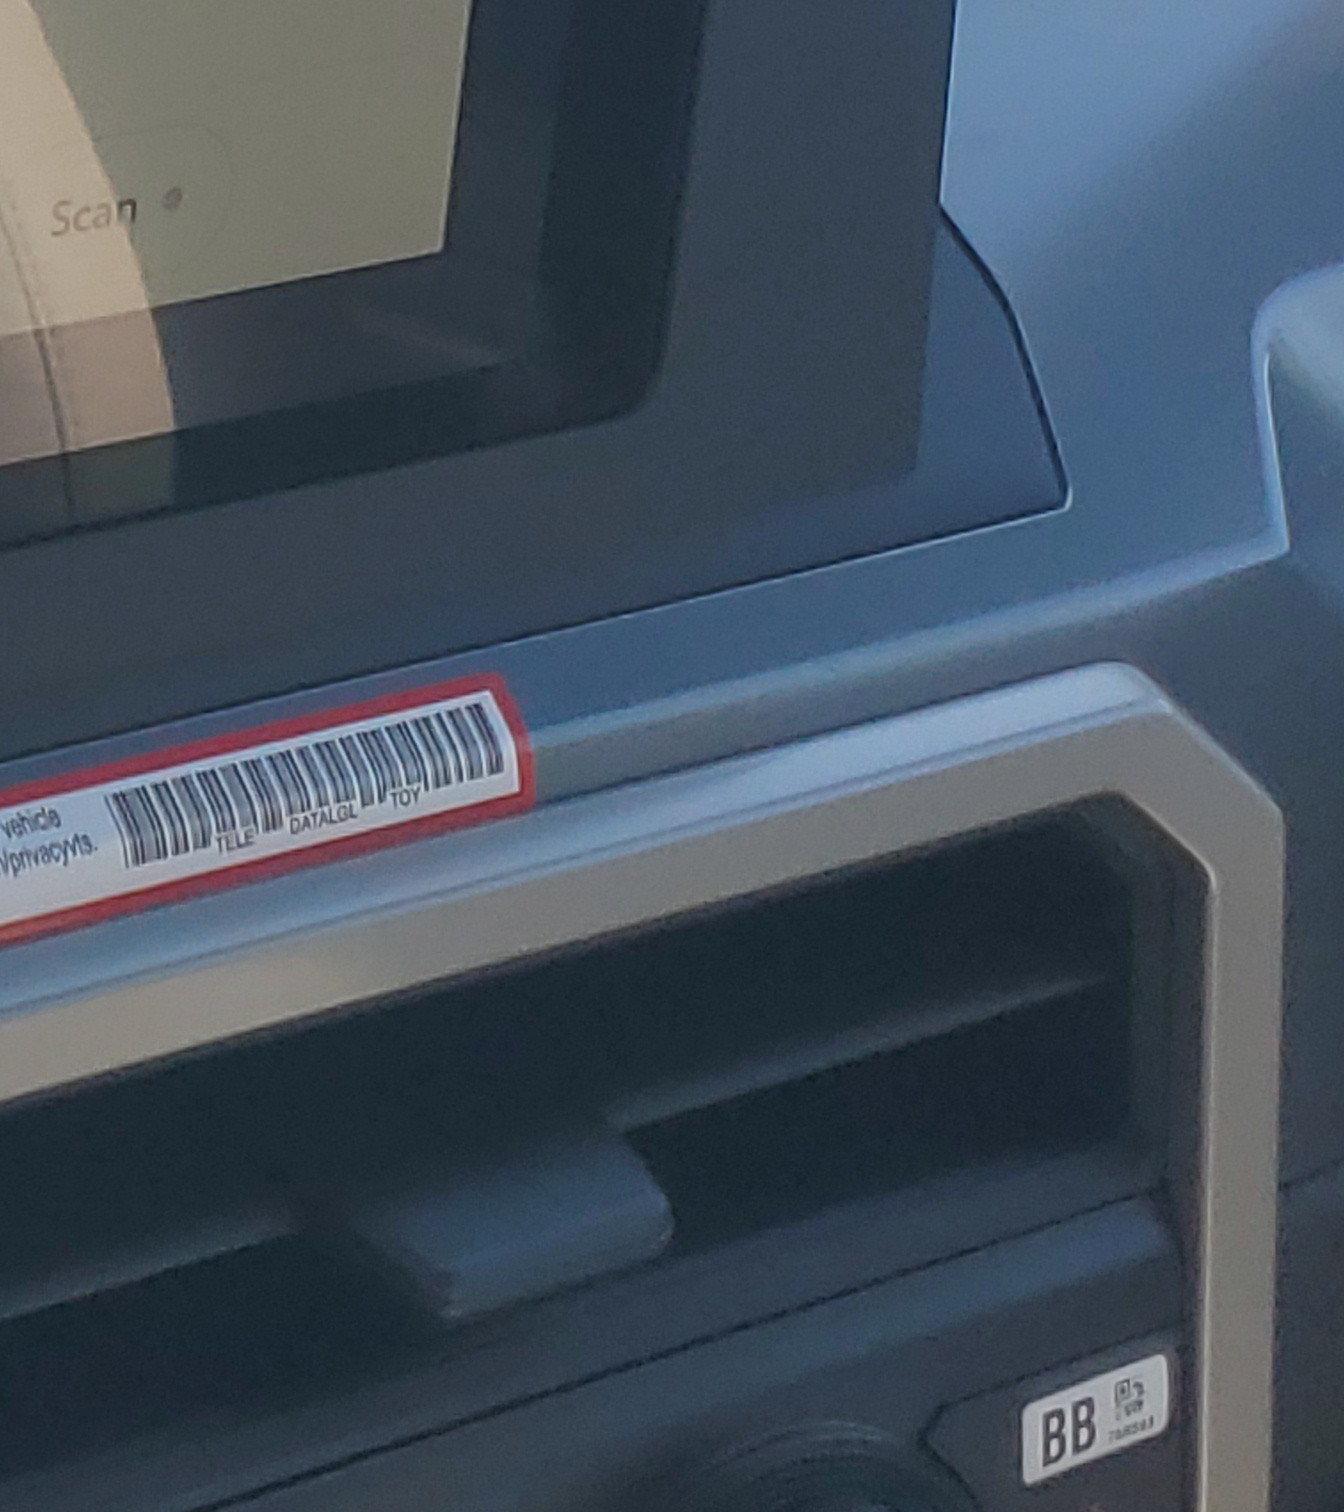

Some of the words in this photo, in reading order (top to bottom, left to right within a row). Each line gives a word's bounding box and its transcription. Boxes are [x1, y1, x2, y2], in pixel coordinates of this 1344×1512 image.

[50, 196, 138, 238] Scan
[0, 806, 62, 840] vehicle
[215, 828, 256, 855] TELE
[389, 783, 424, 810] TOY
[1041, 1395, 1097, 1468] BB
